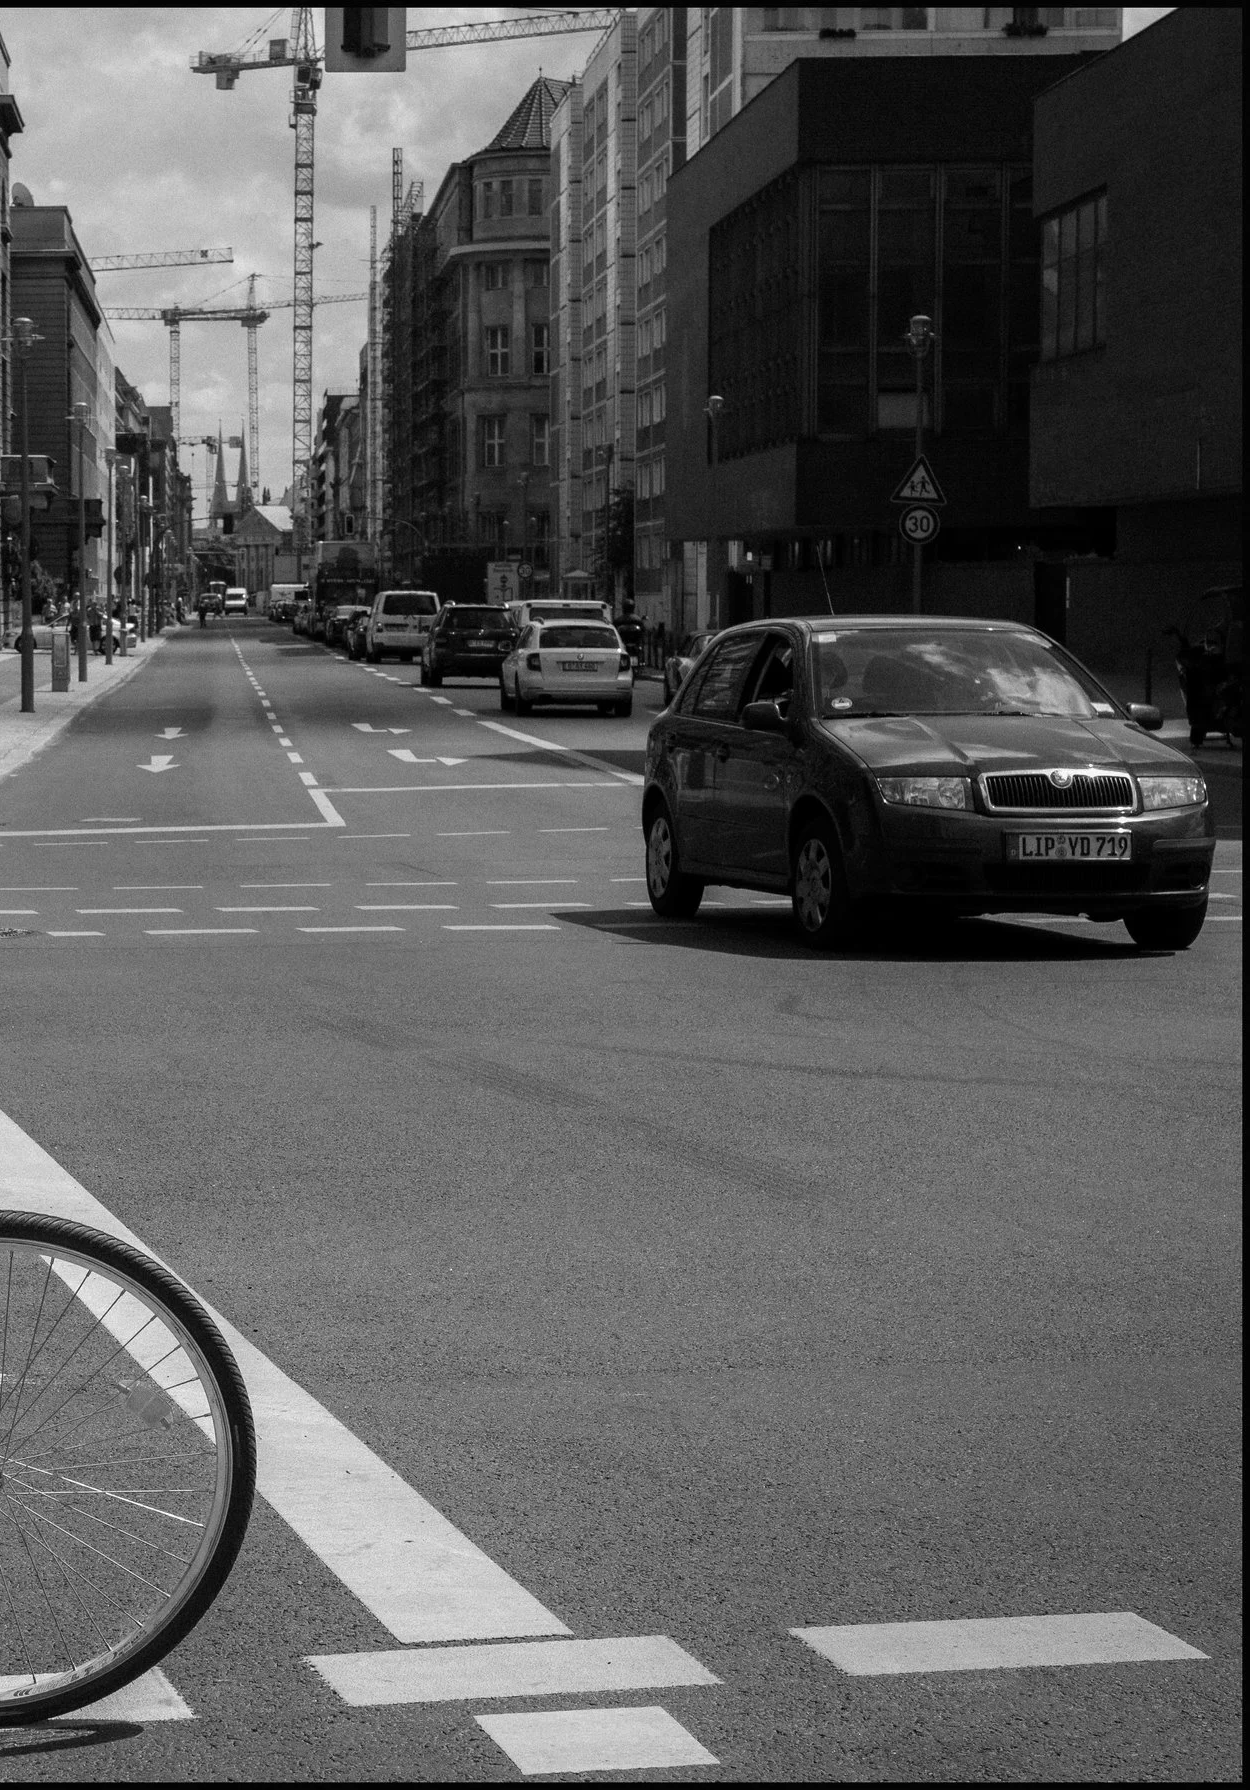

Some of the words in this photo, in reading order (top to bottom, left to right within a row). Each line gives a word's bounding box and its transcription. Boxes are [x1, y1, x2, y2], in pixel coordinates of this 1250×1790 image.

[909, 516, 930, 533] 30
[1022, 837, 1054, 856] LIP
[1068, 837, 1091, 857] YD
[1096, 837, 1129, 857] 719
